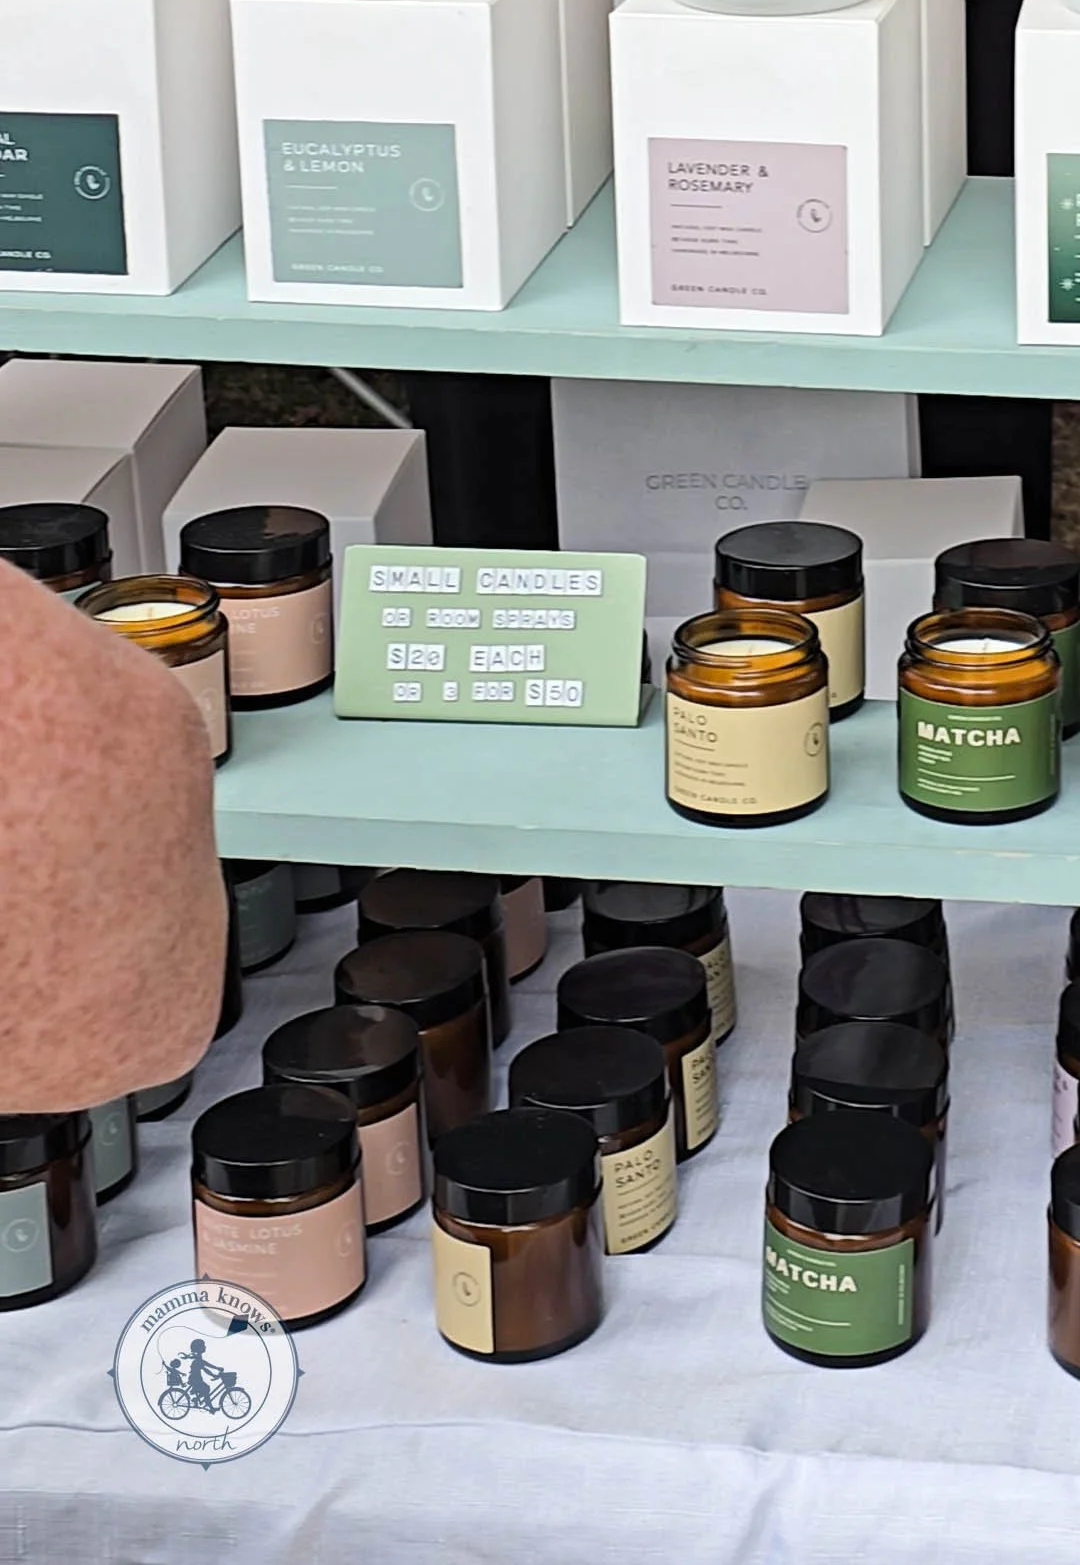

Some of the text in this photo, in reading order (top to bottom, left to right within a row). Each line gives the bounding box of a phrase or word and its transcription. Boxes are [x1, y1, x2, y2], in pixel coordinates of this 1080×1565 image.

[281, 142, 402, 158] EUCALYPTUS
[283, 159, 365, 174] & LEMON
[667, 161, 769, 178] LAVENDER &
[667, 178, 754, 193] ROSEMARY
[645, 472, 810, 491] GREEN CANDLE
[714, 494, 748, 511] CO.
[372, 569, 599, 591] SMALL CANDLES
[384, 611, 573, 627] OR ROOM SPRAYS
[390, 647, 542, 667] $20 EACH
[395, 682, 579, 703] OR 3 FOR $50
[672, 706, 708, 727] PALO
[673, 722, 719, 743] SANTO
[917, 720, 1021, 747] MATCHA
[614, 1149, 653, 1173] PALO
[615, 1158, 661, 1188] SANTO
[249, 1222, 303, 1240] LOTUS
[765, 1245, 858, 1293] MATCHA
